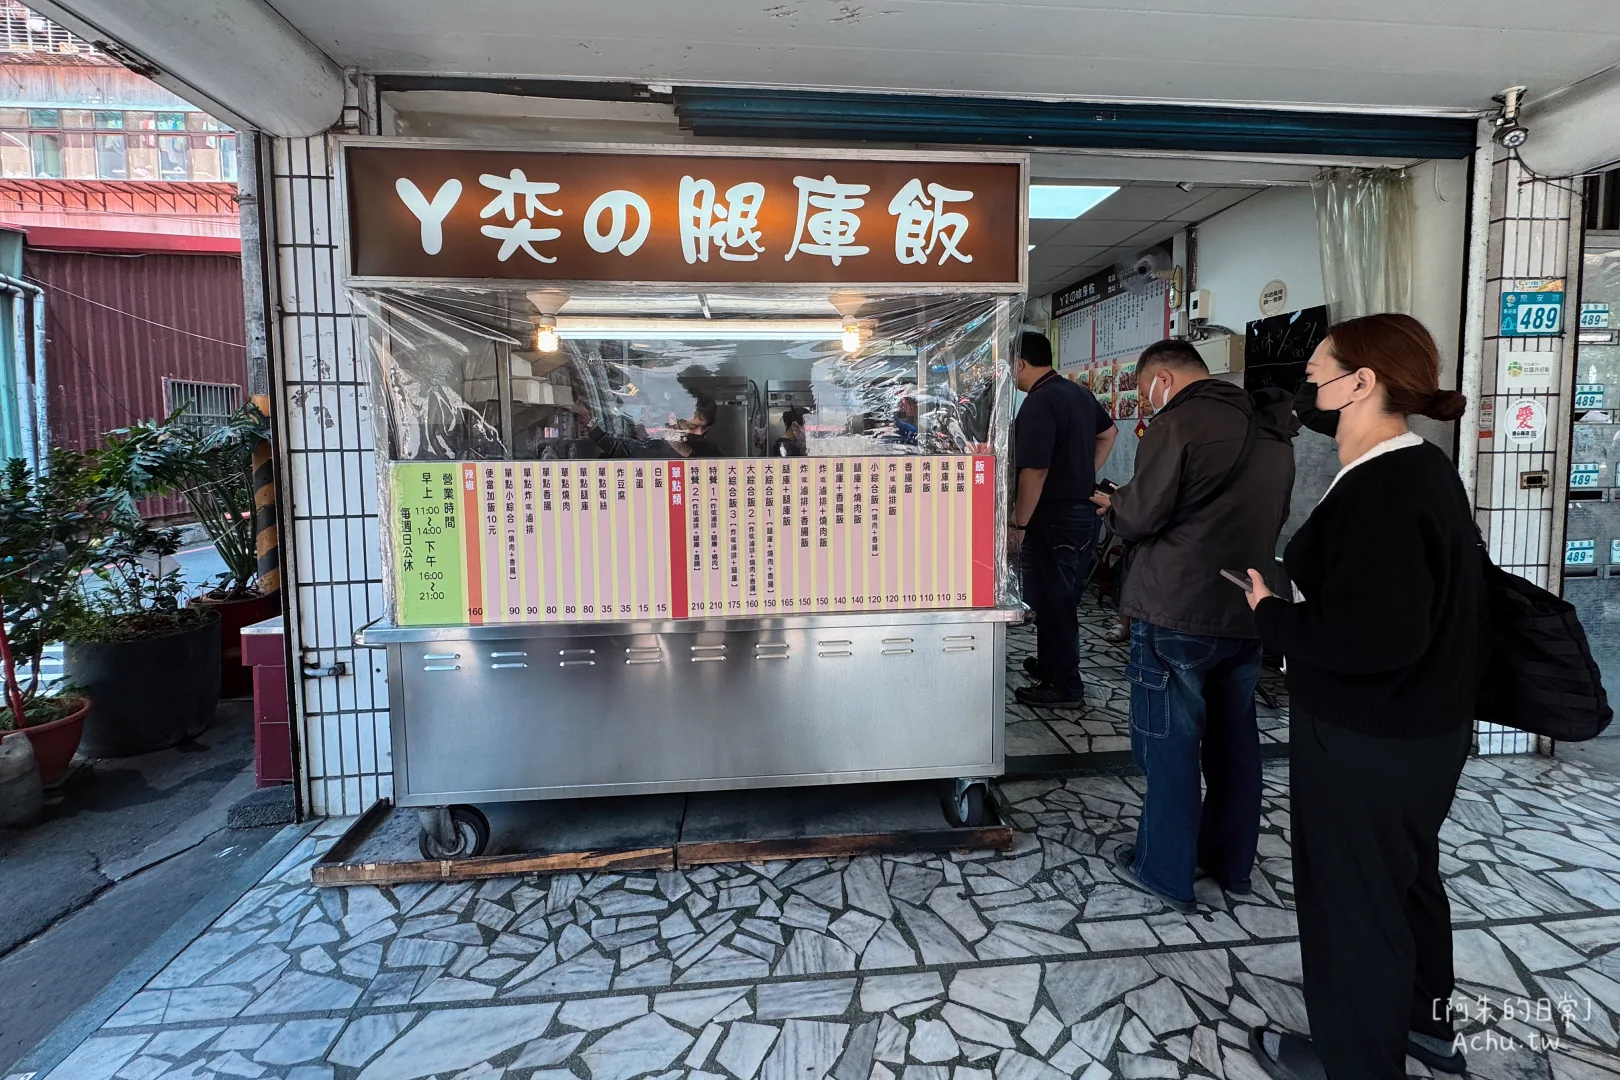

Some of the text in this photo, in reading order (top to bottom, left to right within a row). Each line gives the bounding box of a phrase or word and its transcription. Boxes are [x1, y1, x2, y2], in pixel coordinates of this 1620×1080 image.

[1520, 307, 1558, 330] 489
[1581, 315, 1600, 326] 489
[1576, 396, 1596, 406] 489
[974, 460, 985, 485] 飯類
[1572, 474, 1590, 485] 489
[422, 472, 432, 499] 早上
[672, 466, 682, 506] 單點類
[442, 473, 456, 528] 營業時間
[486, 468, 497, 535] 便當加飯10元
[416, 506, 440, 515] 11:00
[417, 526, 442, 536] 14:00
[902, 462, 916, 602] 香腸飯 110
[920, 462, 934, 602] 燒肉飯 110
[400, 508, 414, 572] 每週日公休
[464, 469, 483, 616] 辣椒 160
[561, 468, 576, 614] 單點燒肉 80
[616, 468, 632, 614] 炸豆腐 35
[635, 468, 649, 613] 滷蛋 15
[654, 468, 667, 612] 白飯 15
[425, 541, 436, 568] 下午
[1566, 551, 1586, 562] 489
[420, 572, 444, 580] 16:00
[420, 592, 444, 600] 21:00
[816, 597, 828, 605] 150
[834, 596, 846, 605] 140
[851, 596, 864, 604] 140
[868, 596, 882, 604] 120
[885, 594, 898, 603] 120
[937, 593, 950, 601] 110
[956, 593, 966, 601] 35
[691, 602, 704, 610] 210
[709, 602, 722, 610] 210
[728, 600, 740, 608] 175
[746, 600, 758, 608] 160
[781, 598, 794, 606] 165
[798, 598, 812, 606] 150
[509, 607, 520, 615] 90
[526, 606, 538, 614] 90
[546, 606, 557, 614] 80
[583, 604, 594, 614] 80
[601, 604, 612, 614] 35
